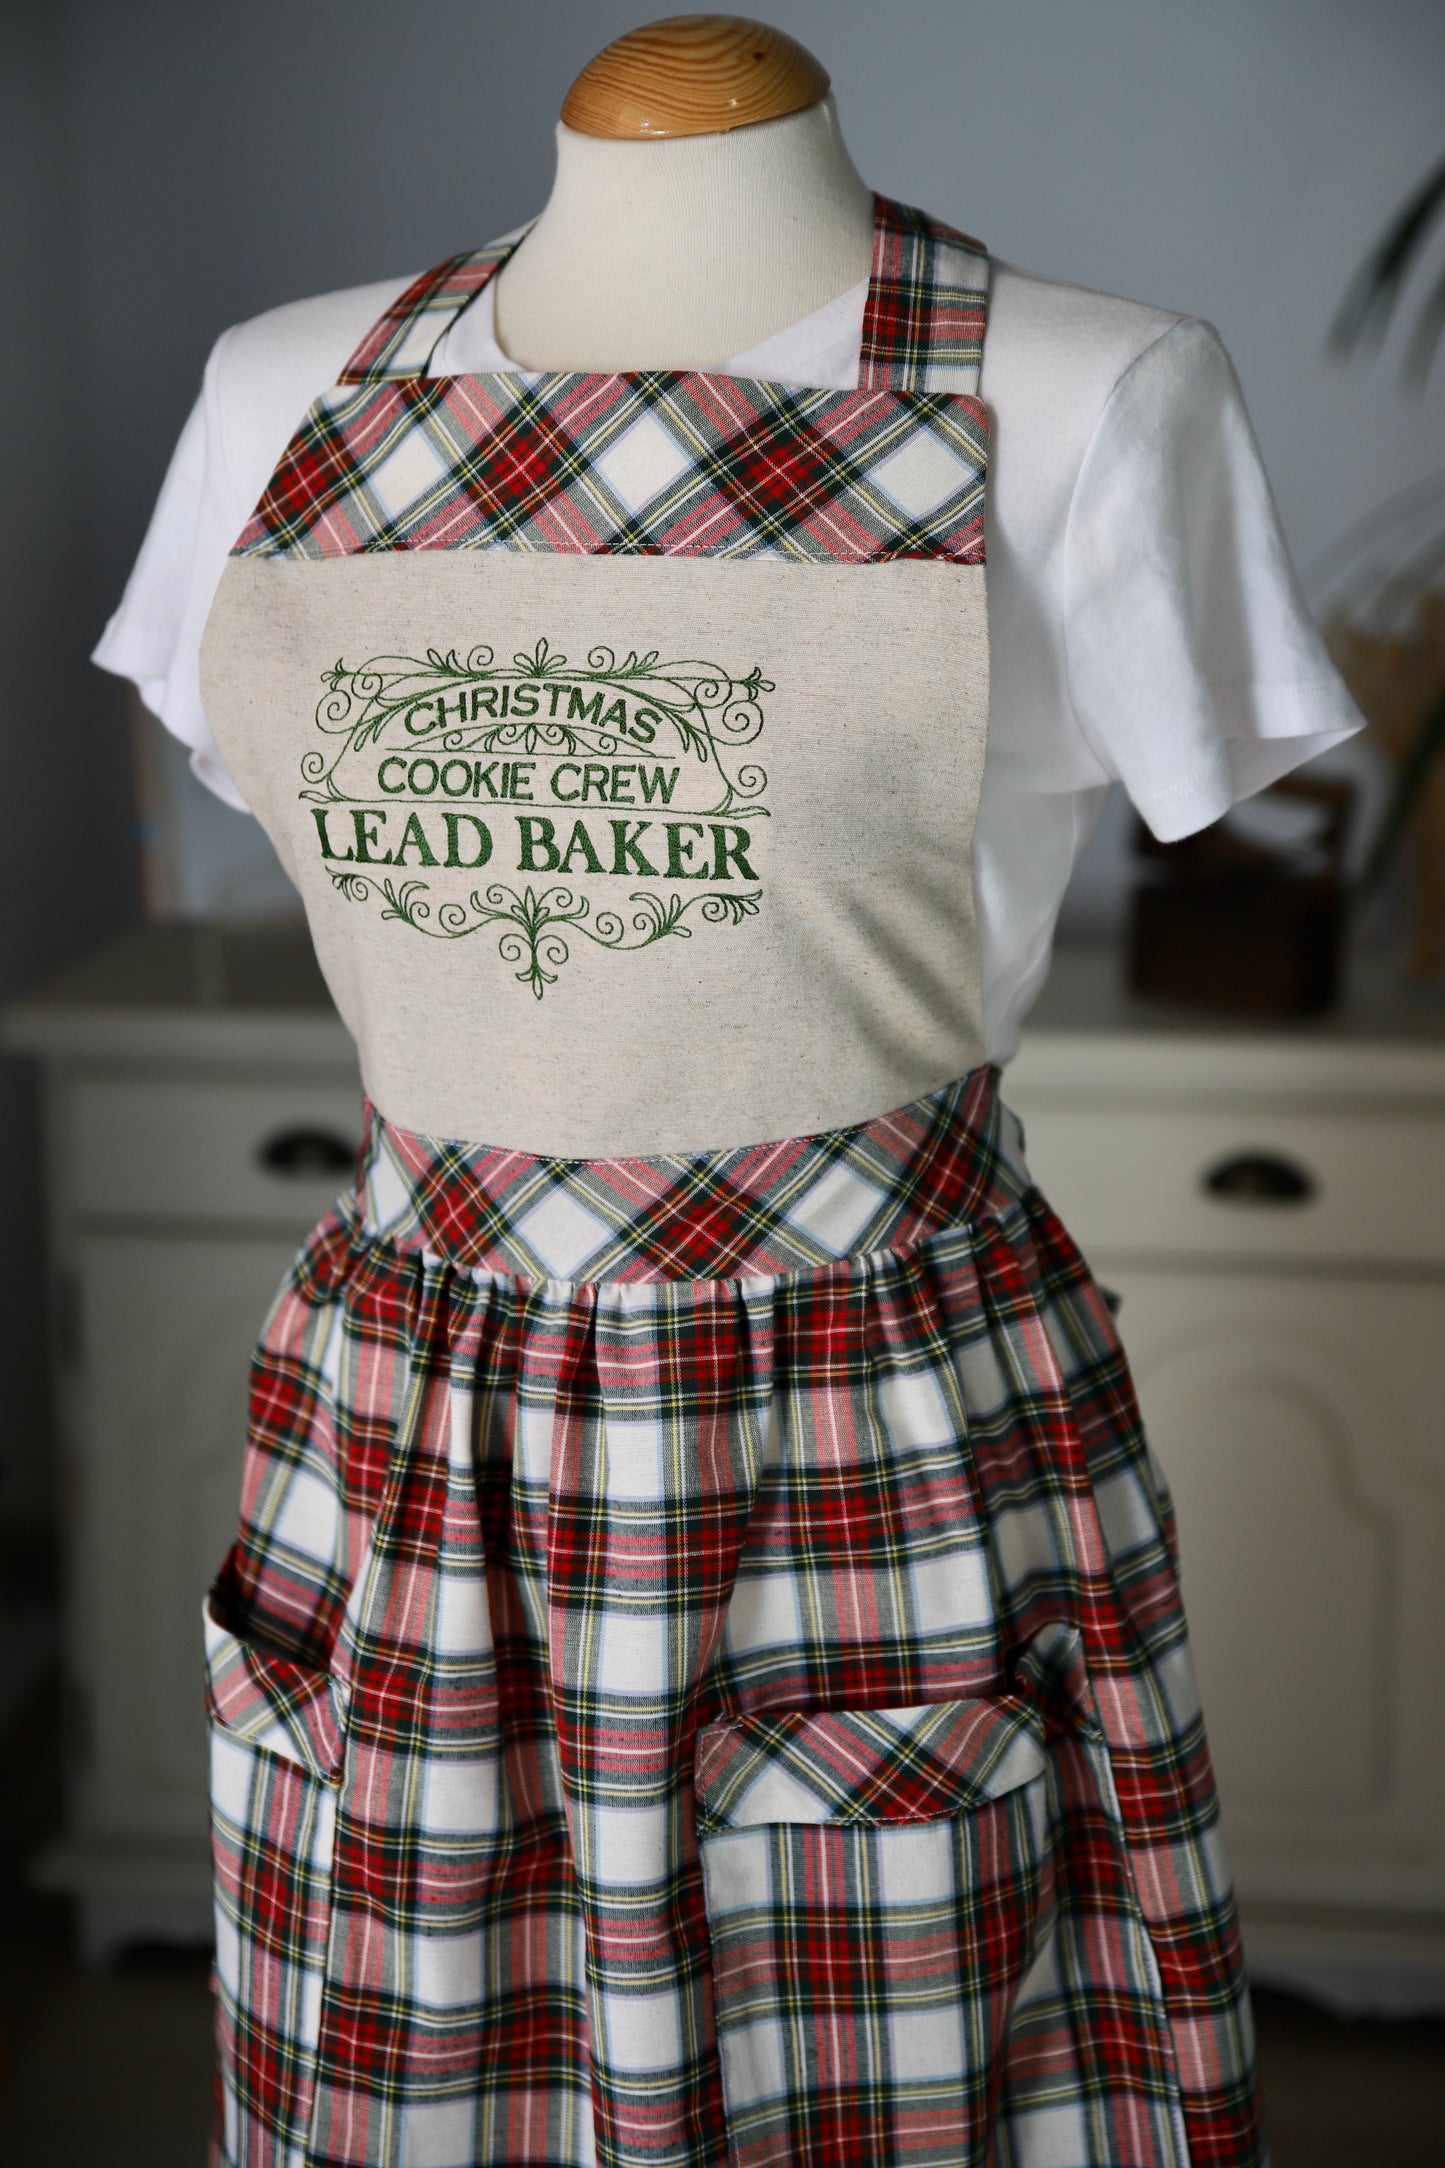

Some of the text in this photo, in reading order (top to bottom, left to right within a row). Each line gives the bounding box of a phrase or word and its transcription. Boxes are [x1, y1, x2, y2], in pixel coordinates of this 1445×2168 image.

[404, 683, 663, 744] CHRISTMAS
[377, 756, 680, 804] COOKIE CREW
[310, 808, 760, 881] LEAD BAKER
